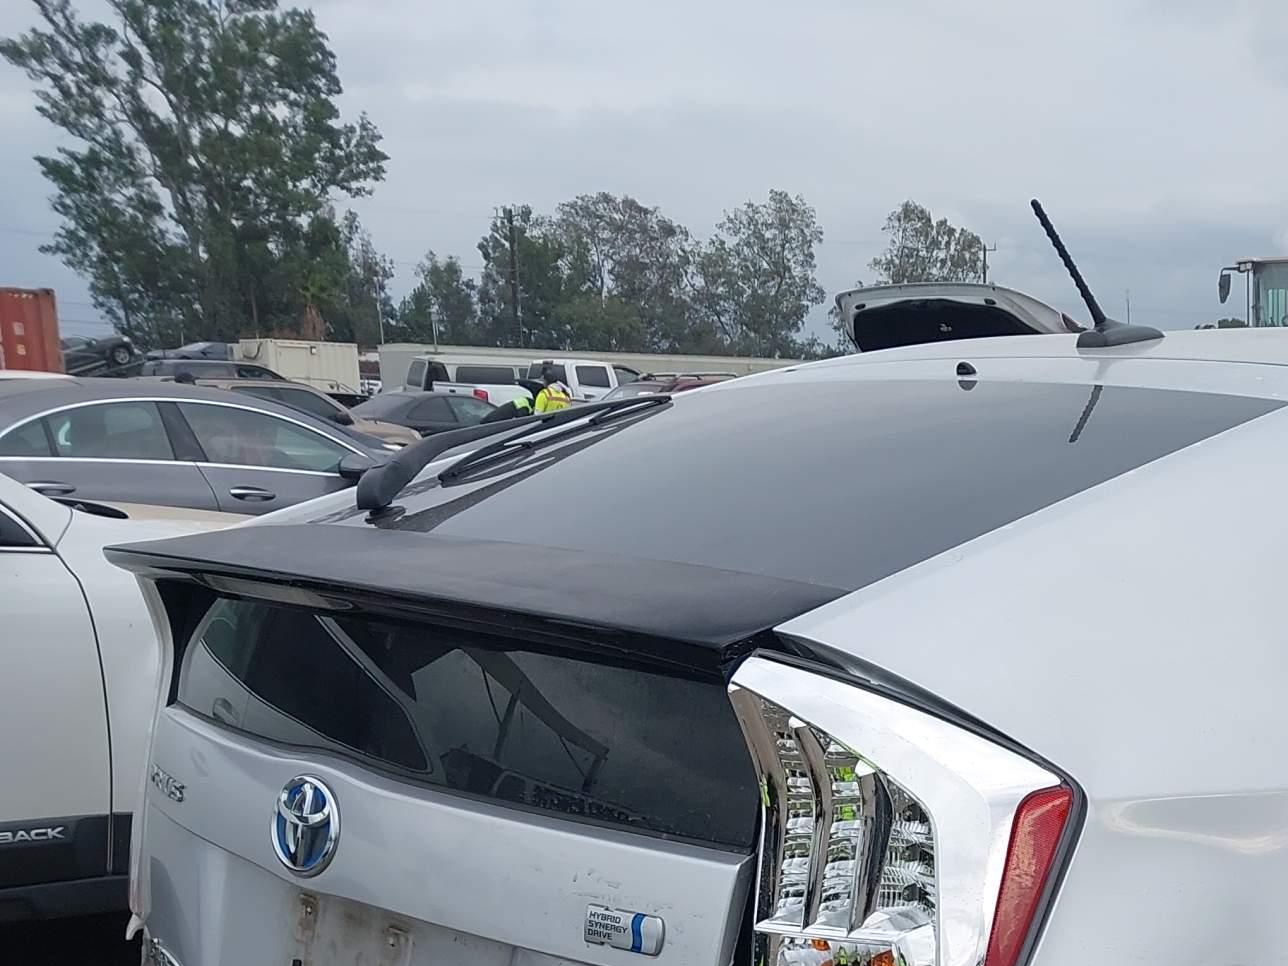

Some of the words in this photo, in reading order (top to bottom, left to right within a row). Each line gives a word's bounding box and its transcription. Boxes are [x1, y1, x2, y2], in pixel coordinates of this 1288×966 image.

[589, 911, 621, 924] HYBRID
[588, 920, 628, 934] SYNERGY
[587, 928, 613, 940] DRIVE
